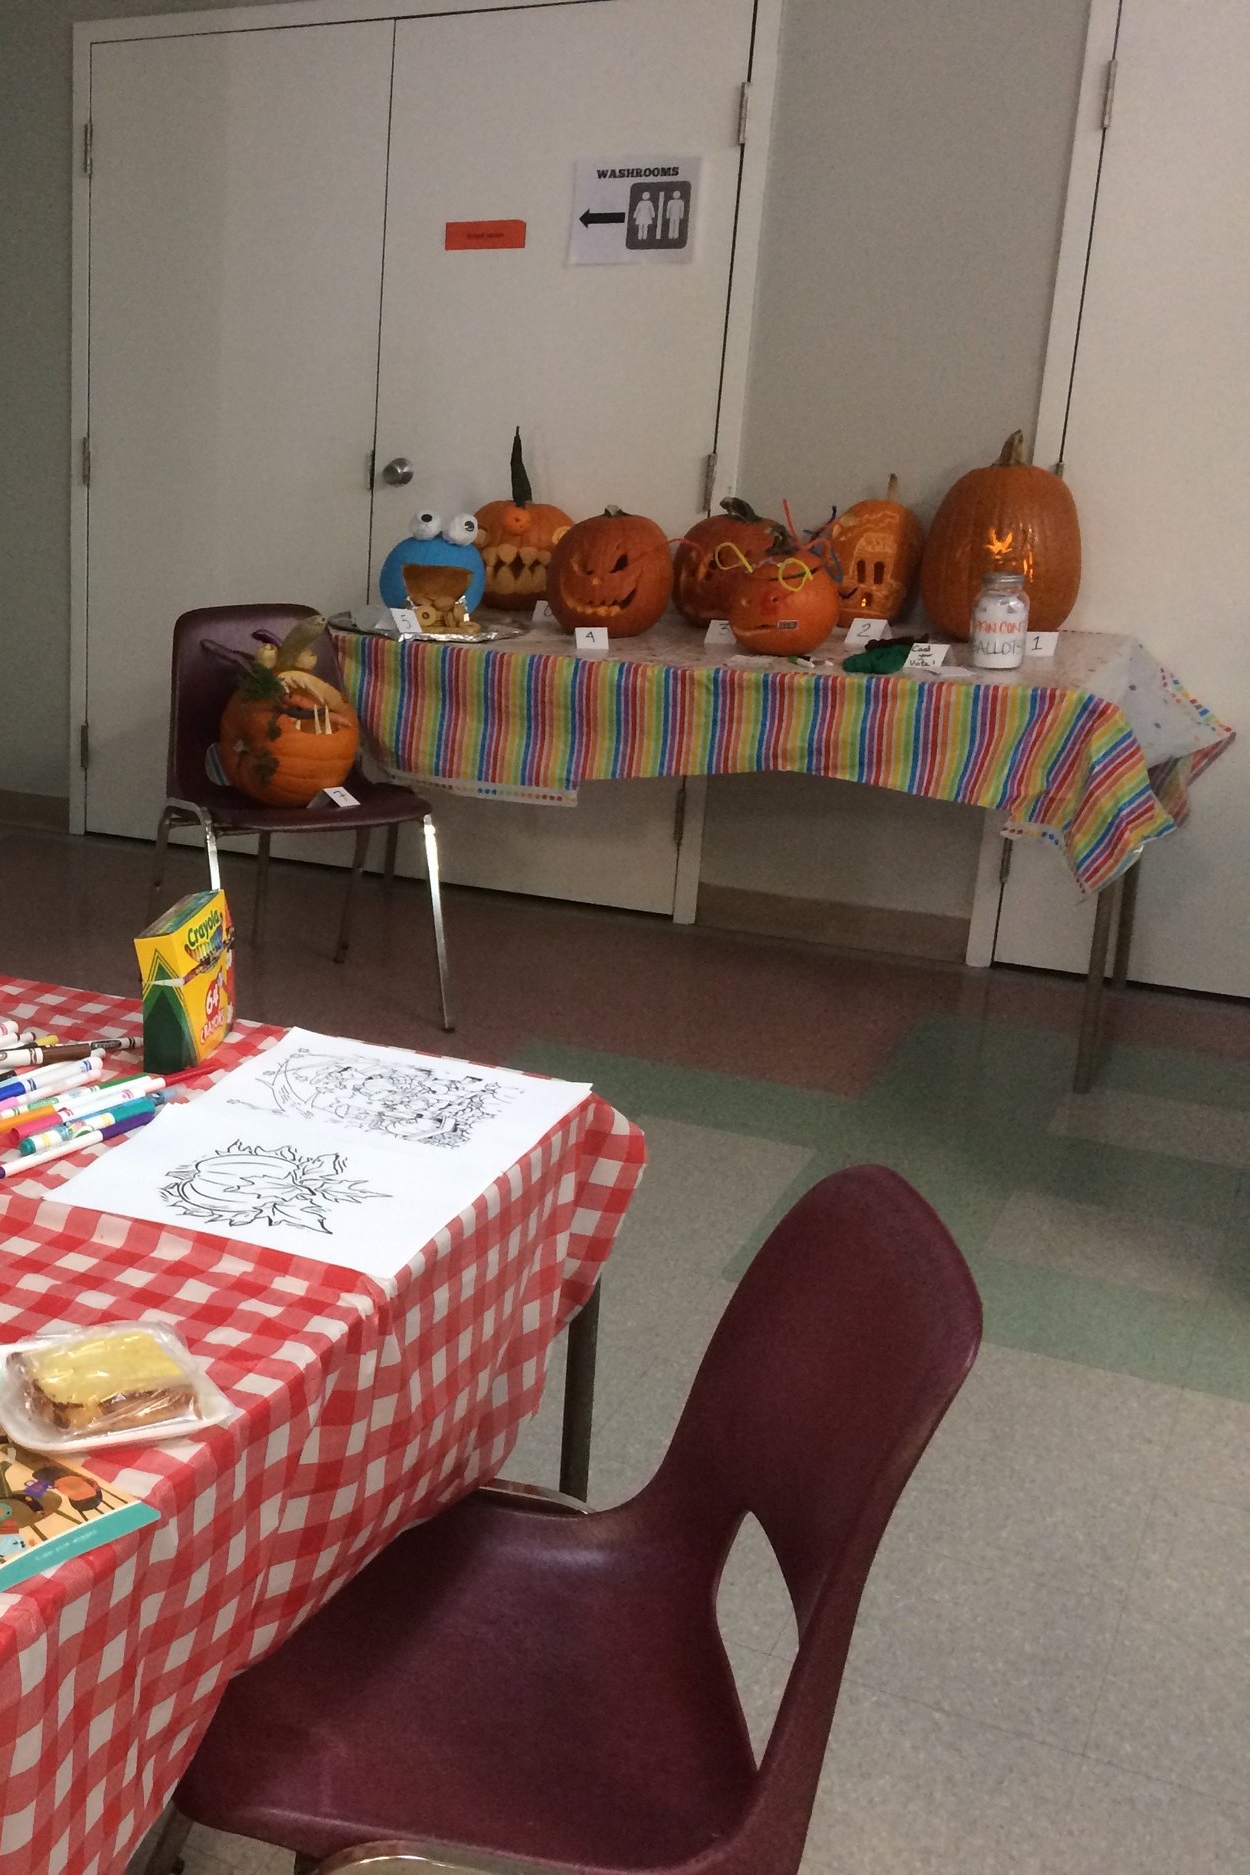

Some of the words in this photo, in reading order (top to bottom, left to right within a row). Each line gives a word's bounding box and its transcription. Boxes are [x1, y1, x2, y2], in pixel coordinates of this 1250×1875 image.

[597, 166, 679, 179] WASHROOMS
[400, 614, 411, 629] 5
[857, 622, 871, 637] 2
[1032, 636, 1043, 650] 1
[187, 909, 221, 948] Crayola
[206, 984, 220, 1014] 64
[200, 1012, 225, 1045] CRAYONS
